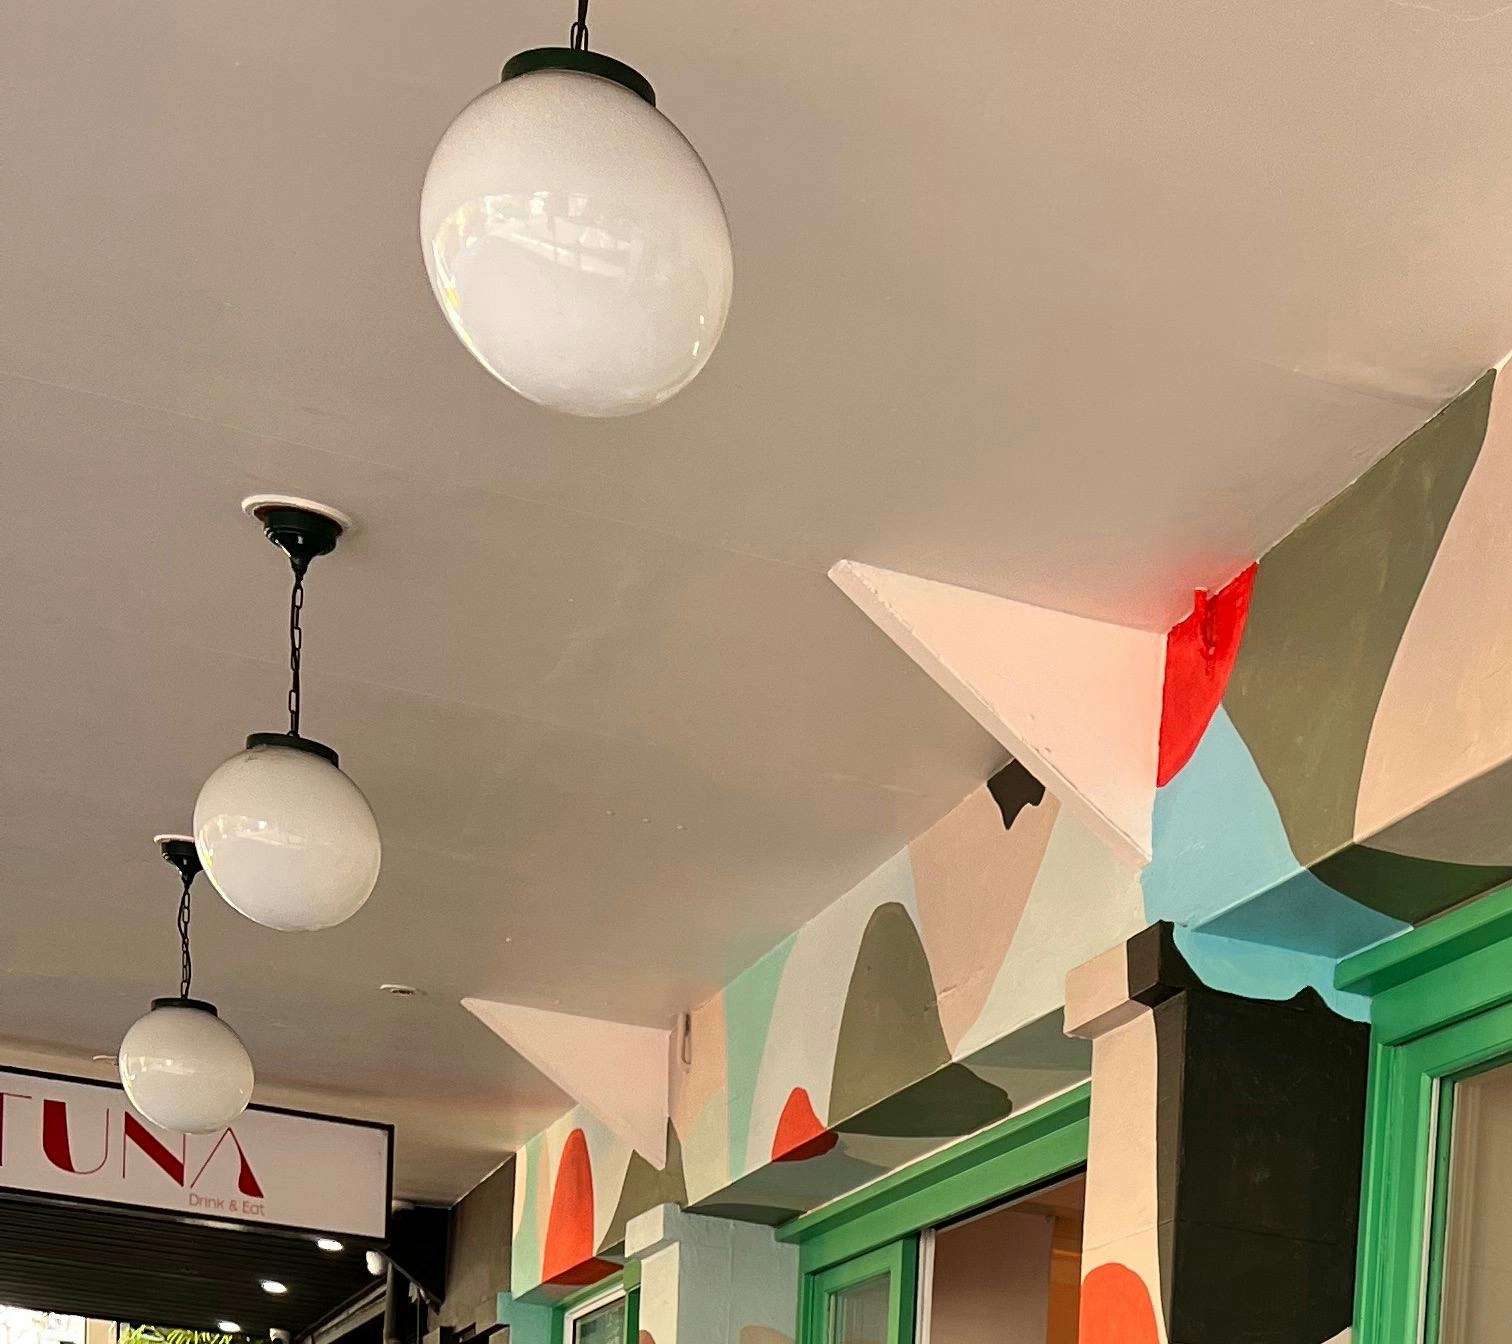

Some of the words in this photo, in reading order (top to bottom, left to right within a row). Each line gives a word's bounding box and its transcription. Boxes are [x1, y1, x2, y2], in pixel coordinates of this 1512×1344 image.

[189, 1193, 224, 1210] Drink
[229, 1199, 238, 1212] &
[243, 1200, 265, 1216] Eat
